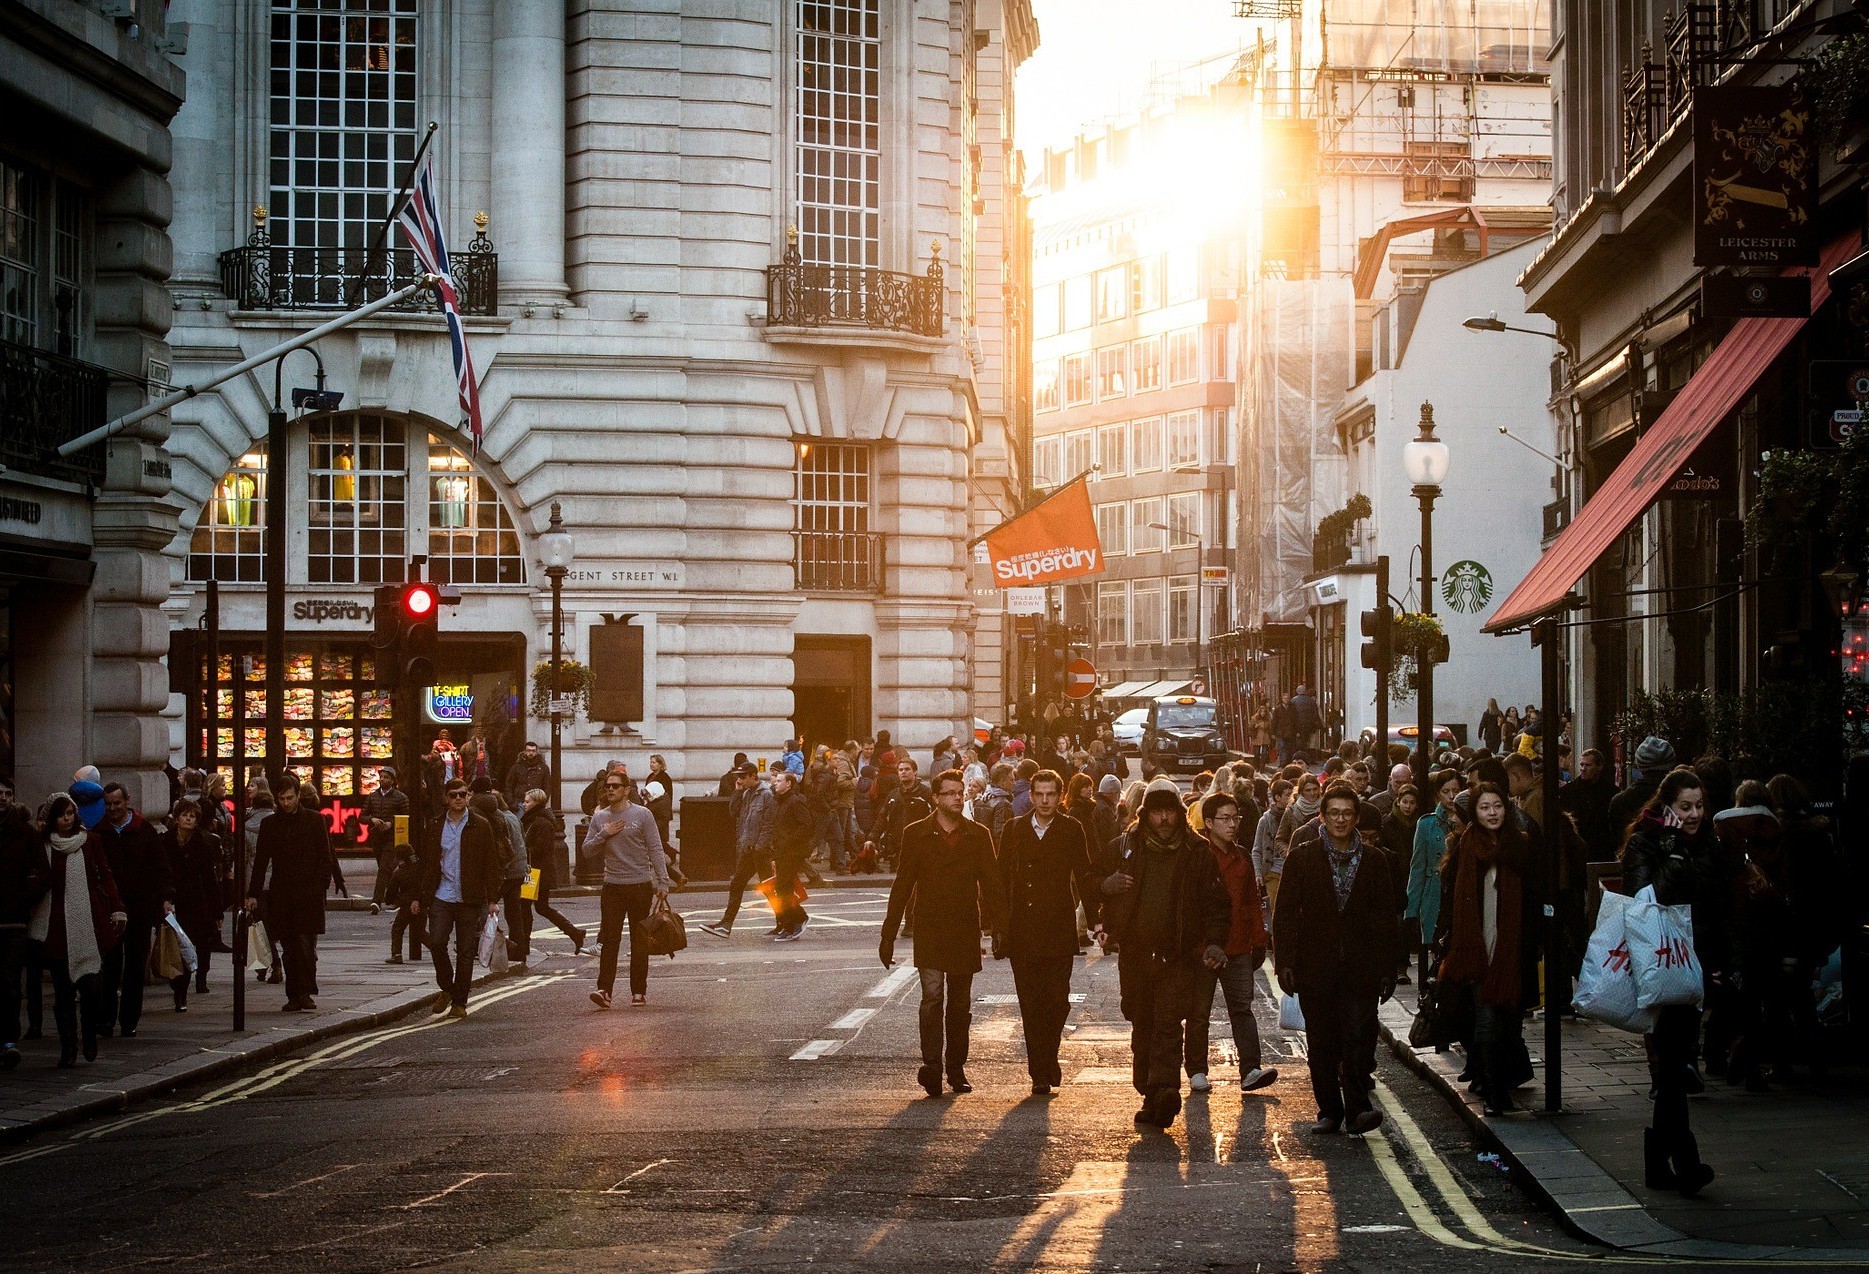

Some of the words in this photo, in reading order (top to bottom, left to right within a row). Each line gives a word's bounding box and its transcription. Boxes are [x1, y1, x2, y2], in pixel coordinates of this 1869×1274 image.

[1720, 237, 1797, 248] LEICESTER
[1739, 251, 1779, 260] ARMS
[995, 547, 1097, 580] Superdry
[611, 571, 655, 581] STREET
[293, 601, 375, 624] Superdry
[433, 685, 469, 696] T-SHIRT
[1602, 939, 1633, 977] H&
[1654, 934, 1693, 971] H&M
